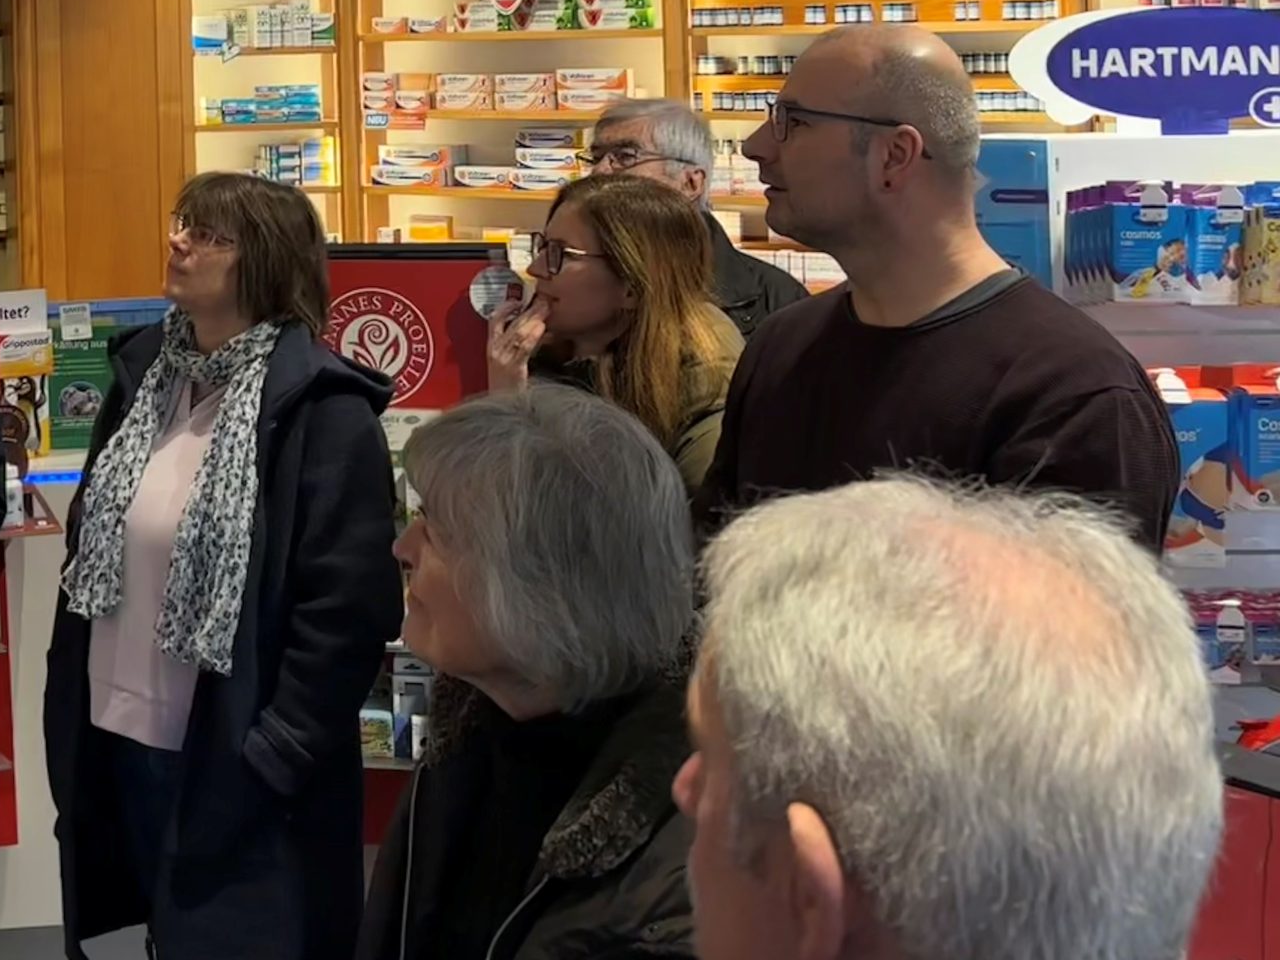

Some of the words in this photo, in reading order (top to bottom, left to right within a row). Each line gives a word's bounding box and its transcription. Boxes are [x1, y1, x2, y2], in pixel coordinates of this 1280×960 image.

[1071, 45, 1280, 78] HARTMAN
[323, 296, 382, 350] ANNES
[389, 300, 427, 396] PROELLE
